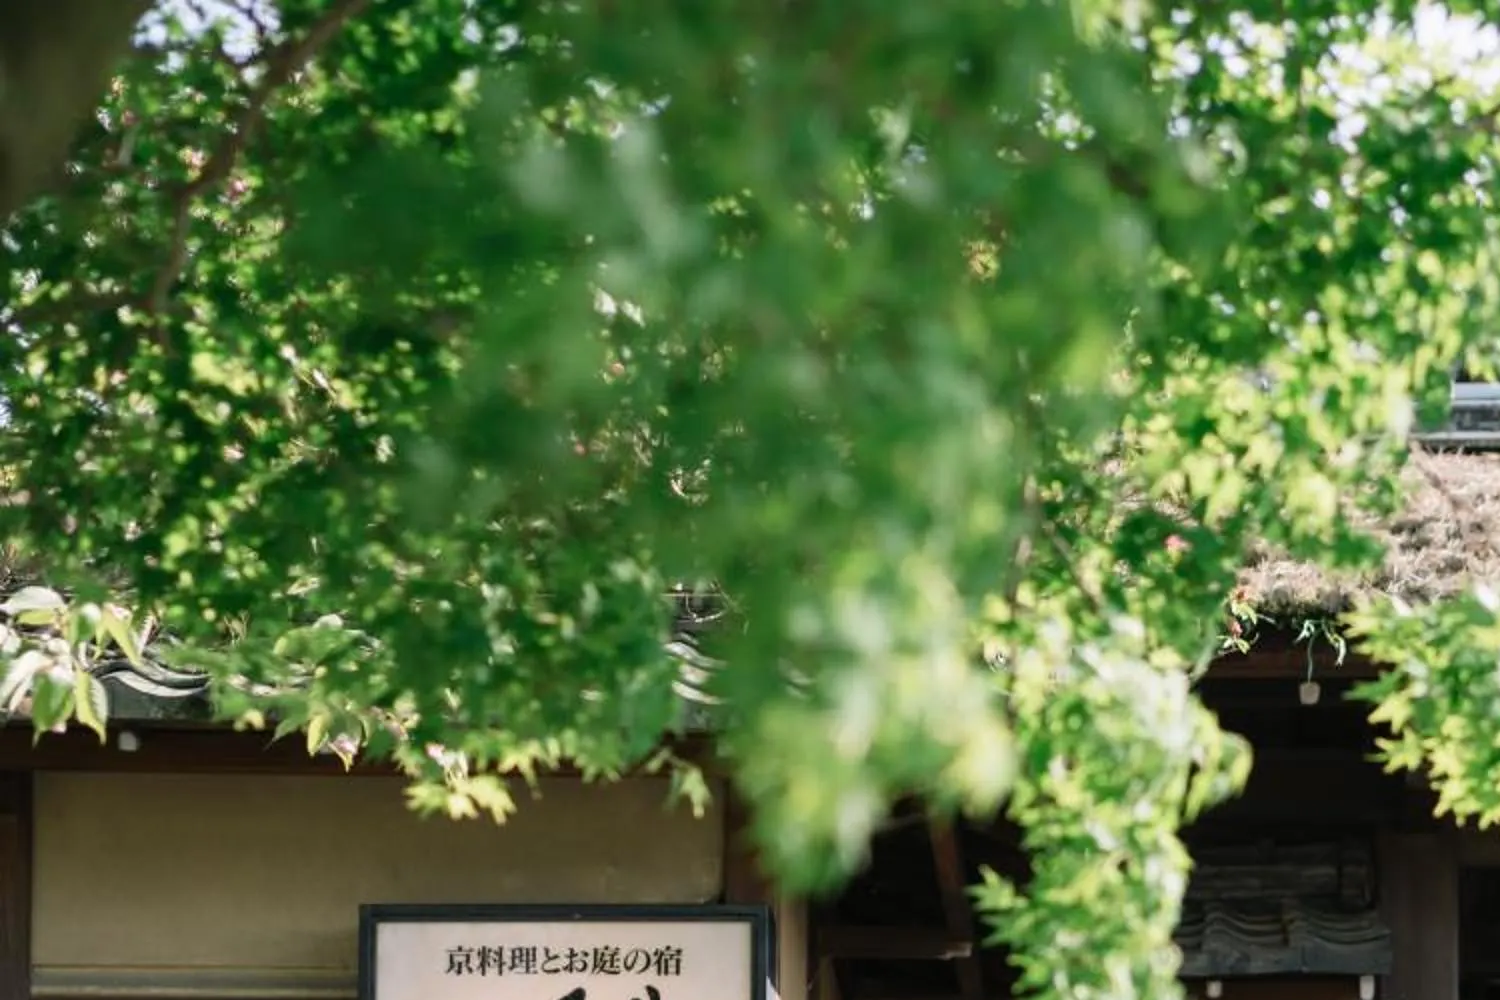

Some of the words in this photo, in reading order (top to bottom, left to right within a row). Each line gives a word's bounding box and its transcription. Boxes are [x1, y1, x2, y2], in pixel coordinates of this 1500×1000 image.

[445, 945, 683, 976] 京料理とお庭の宿
